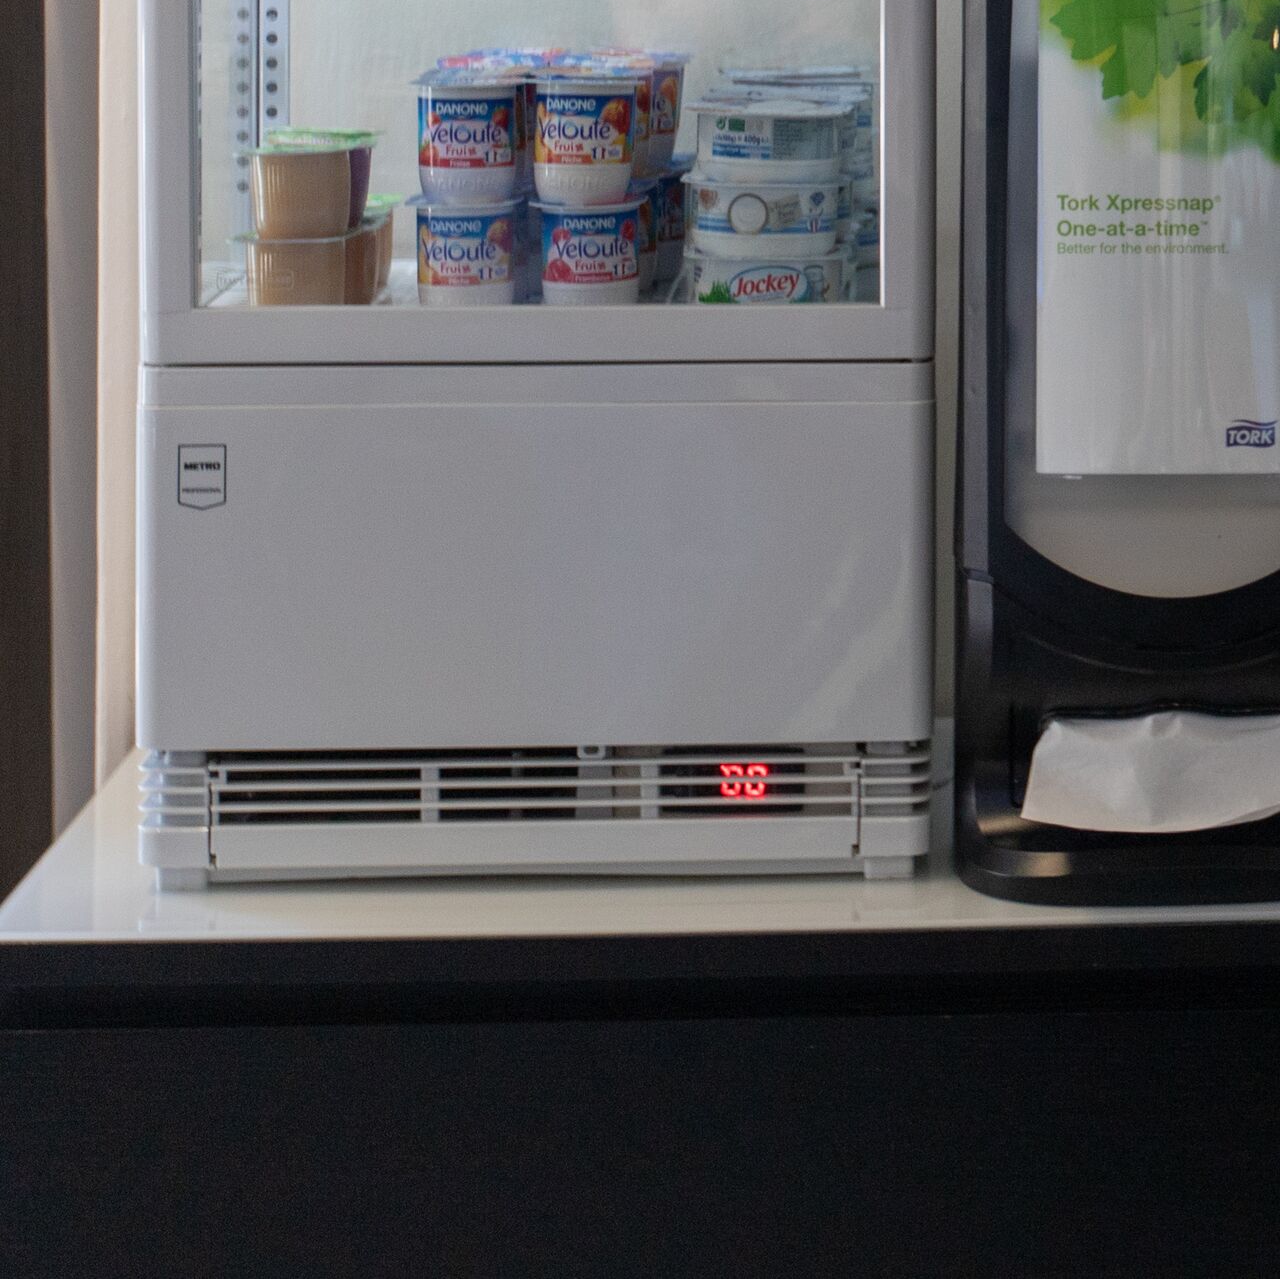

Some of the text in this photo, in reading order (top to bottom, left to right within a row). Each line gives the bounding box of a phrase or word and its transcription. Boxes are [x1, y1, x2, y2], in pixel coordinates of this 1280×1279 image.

[435, 102, 488, 115] DANONE
[546, 98, 596, 111] DANONE
[1057, 194, 1100, 211] Tork
[431, 220, 482, 233] DANONE
[563, 217, 616, 230] DANONE
[1057, 242, 1229, 254] Better for the environment.
[733, 273, 800, 298] Jockey
[1228, 429, 1273, 444] TORK
[183, 462, 221, 471] METRO
